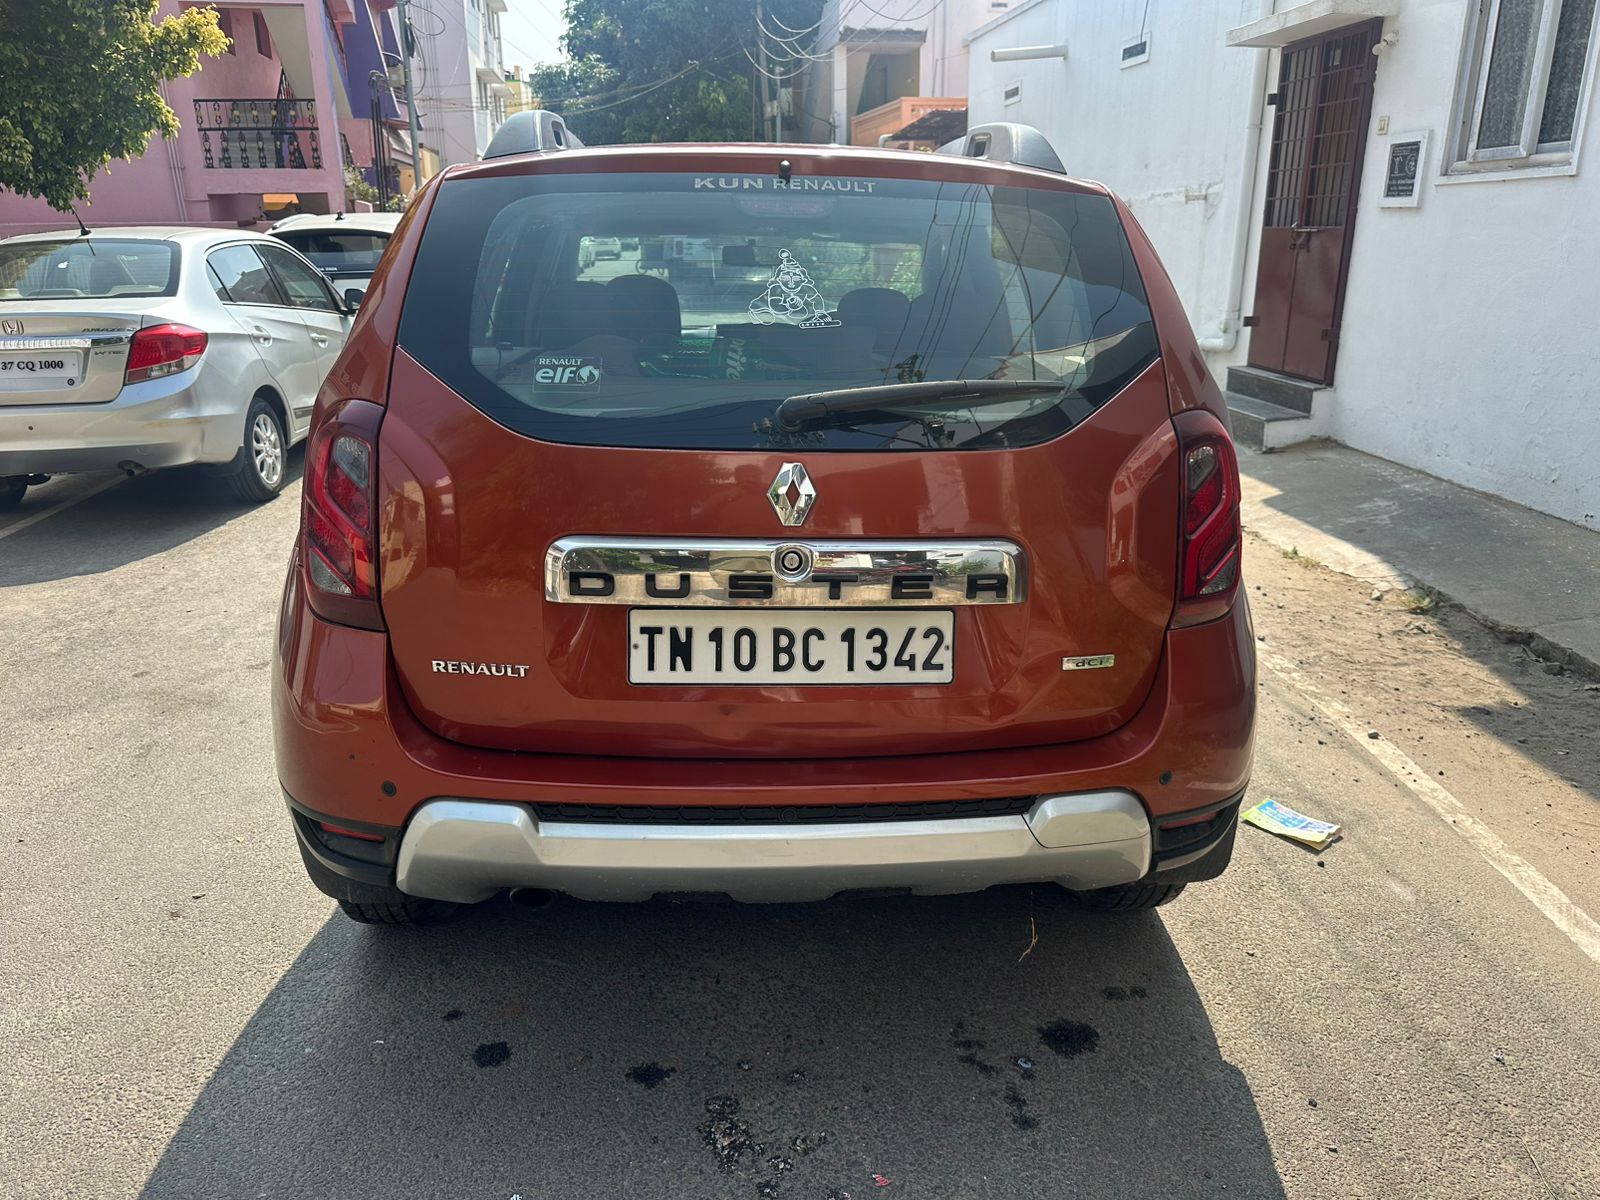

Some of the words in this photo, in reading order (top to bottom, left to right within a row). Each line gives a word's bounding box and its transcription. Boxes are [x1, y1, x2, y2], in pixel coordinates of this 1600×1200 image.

[694, 177, 763, 189] KUN
[773, 178, 876, 193] RENAULT
[1, 361, 14, 370] 37
[16, 361, 36, 371] CQ
[39, 360, 64, 369] 1000
[726, 338, 747, 380] prite
[535, 367, 577, 383] elf
[569, 571, 1009, 600] DUSTER
[639, 626, 693, 672] TN
[708, 627, 757, 672] 10
[772, 627, 825, 672] BC
[840, 627, 945, 672] 1342
[431, 660, 530, 678] RENAULT
